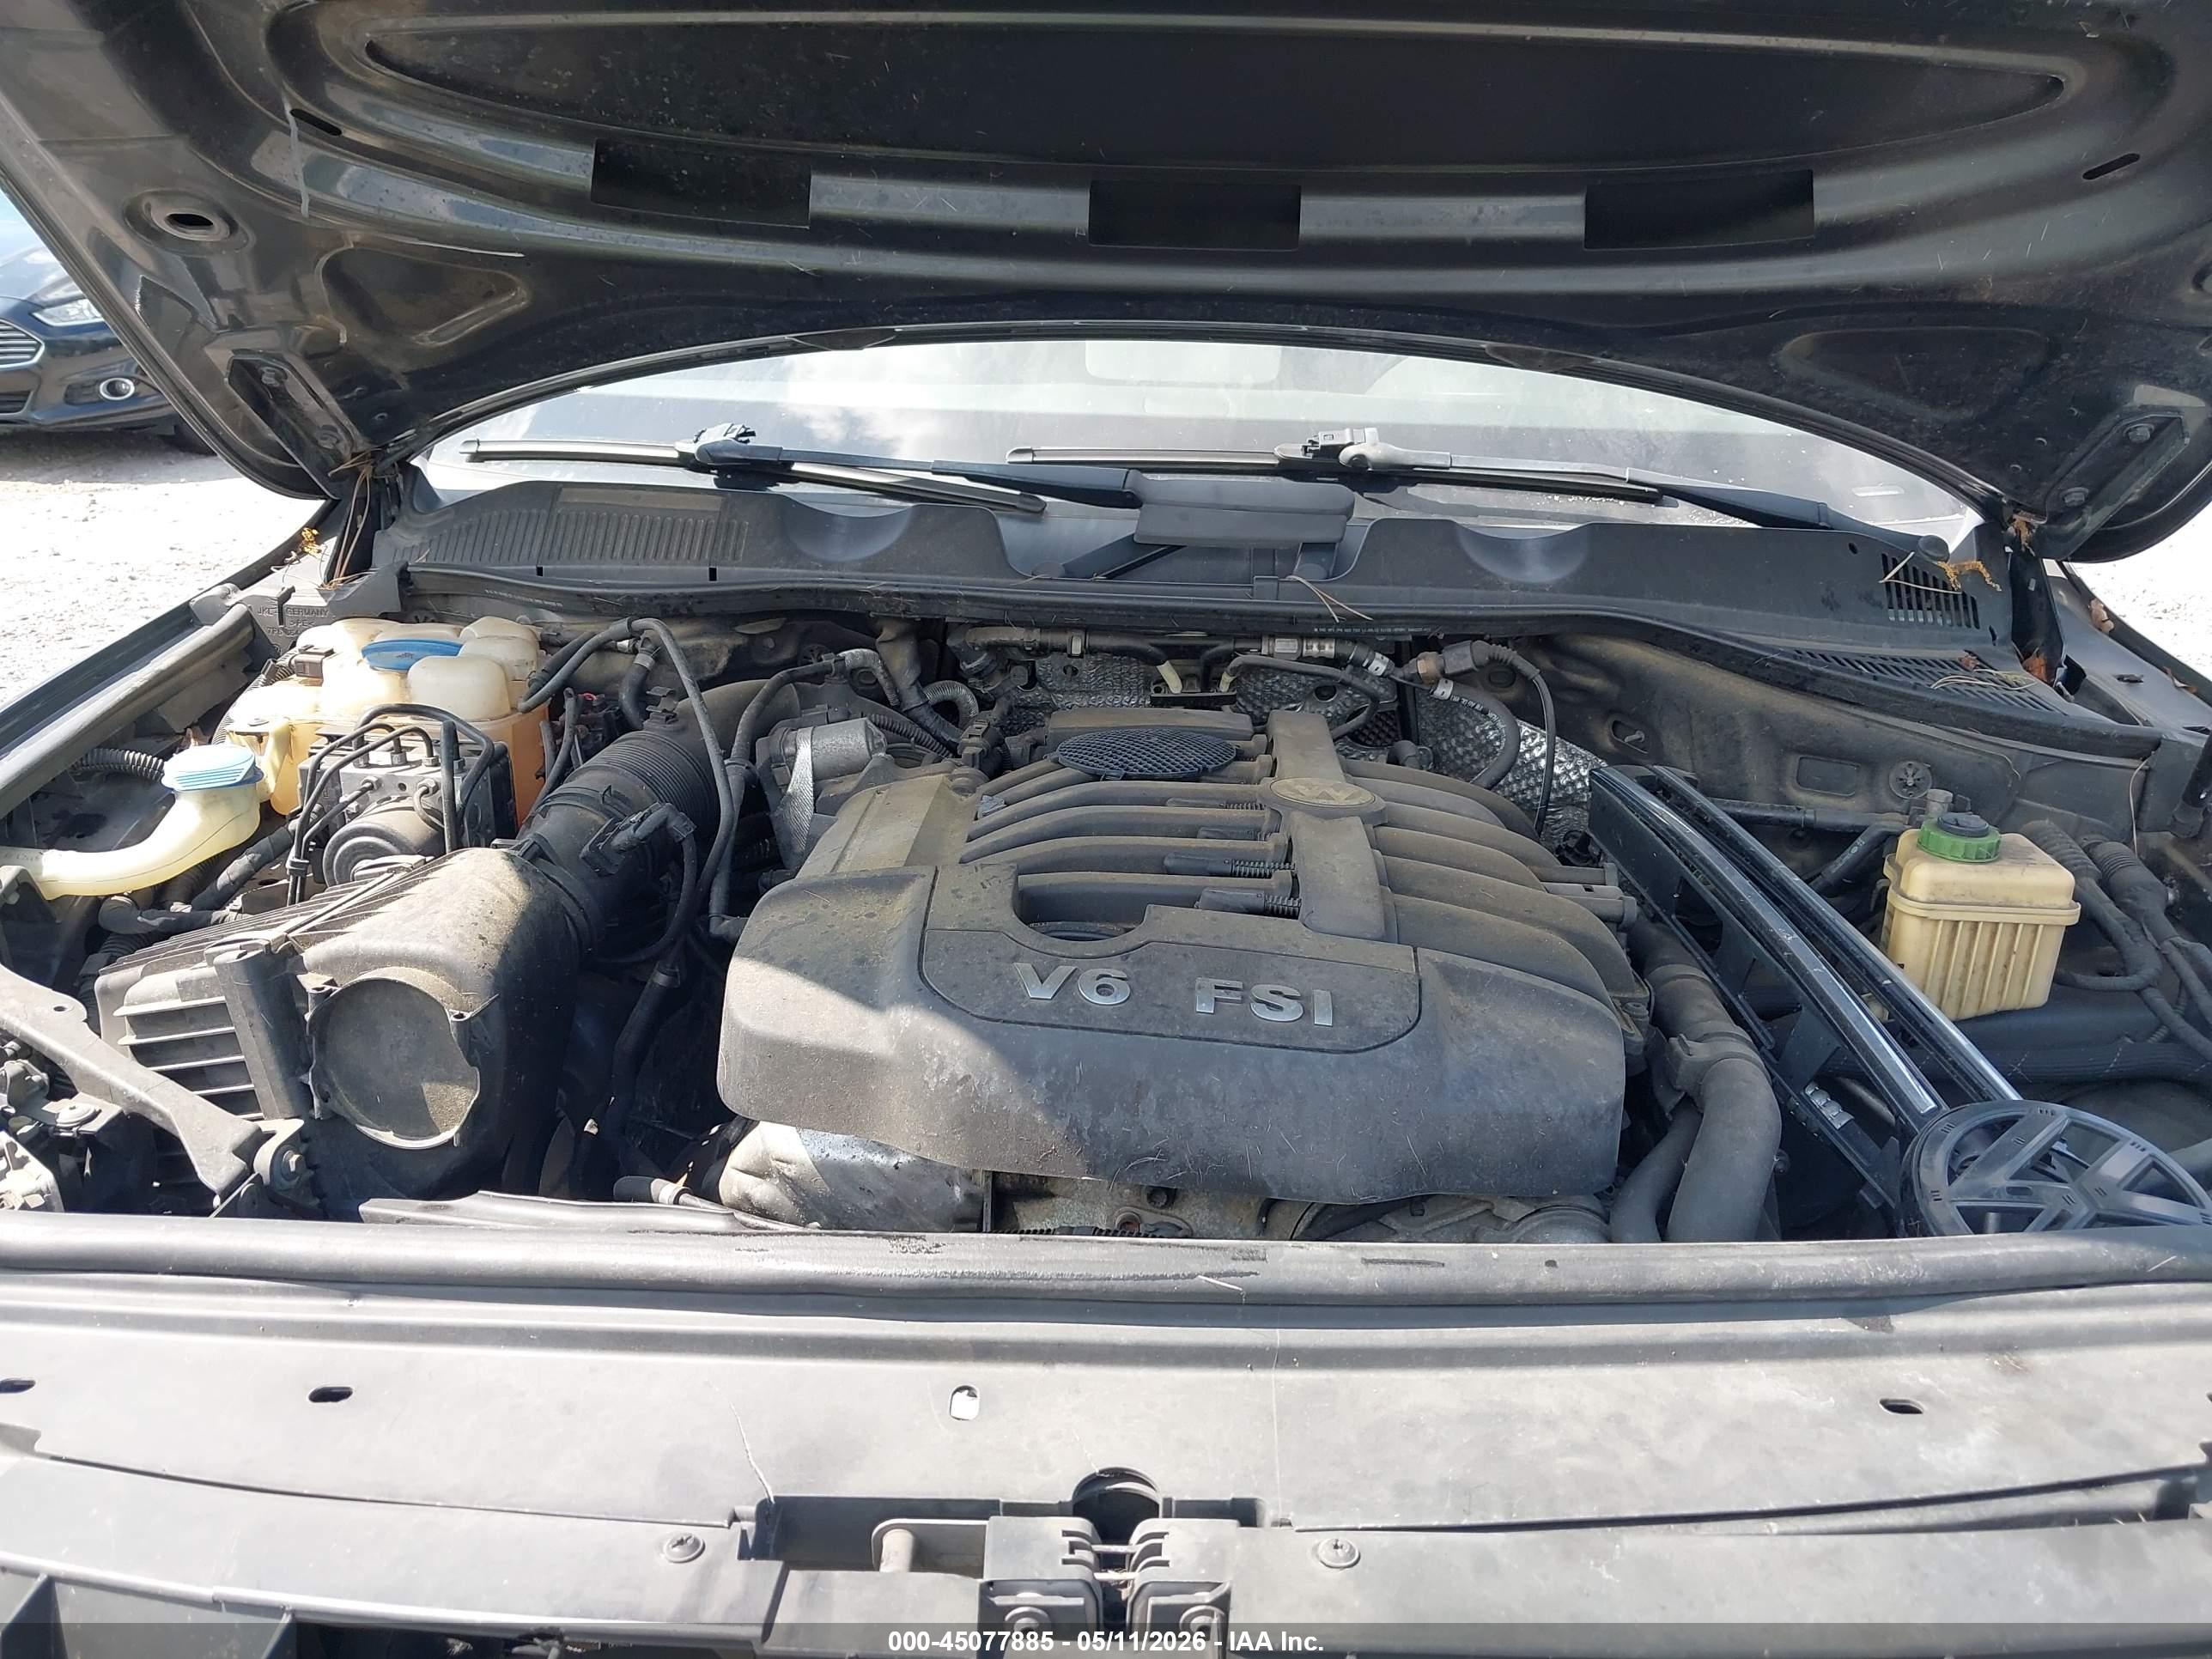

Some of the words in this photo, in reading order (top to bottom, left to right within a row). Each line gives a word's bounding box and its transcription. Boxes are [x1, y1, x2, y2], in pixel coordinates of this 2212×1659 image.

[286, 606, 330, 617] GERMANY
[1012, 962, 1131, 1006] V6
[1195, 977, 1333, 1026] FSI
